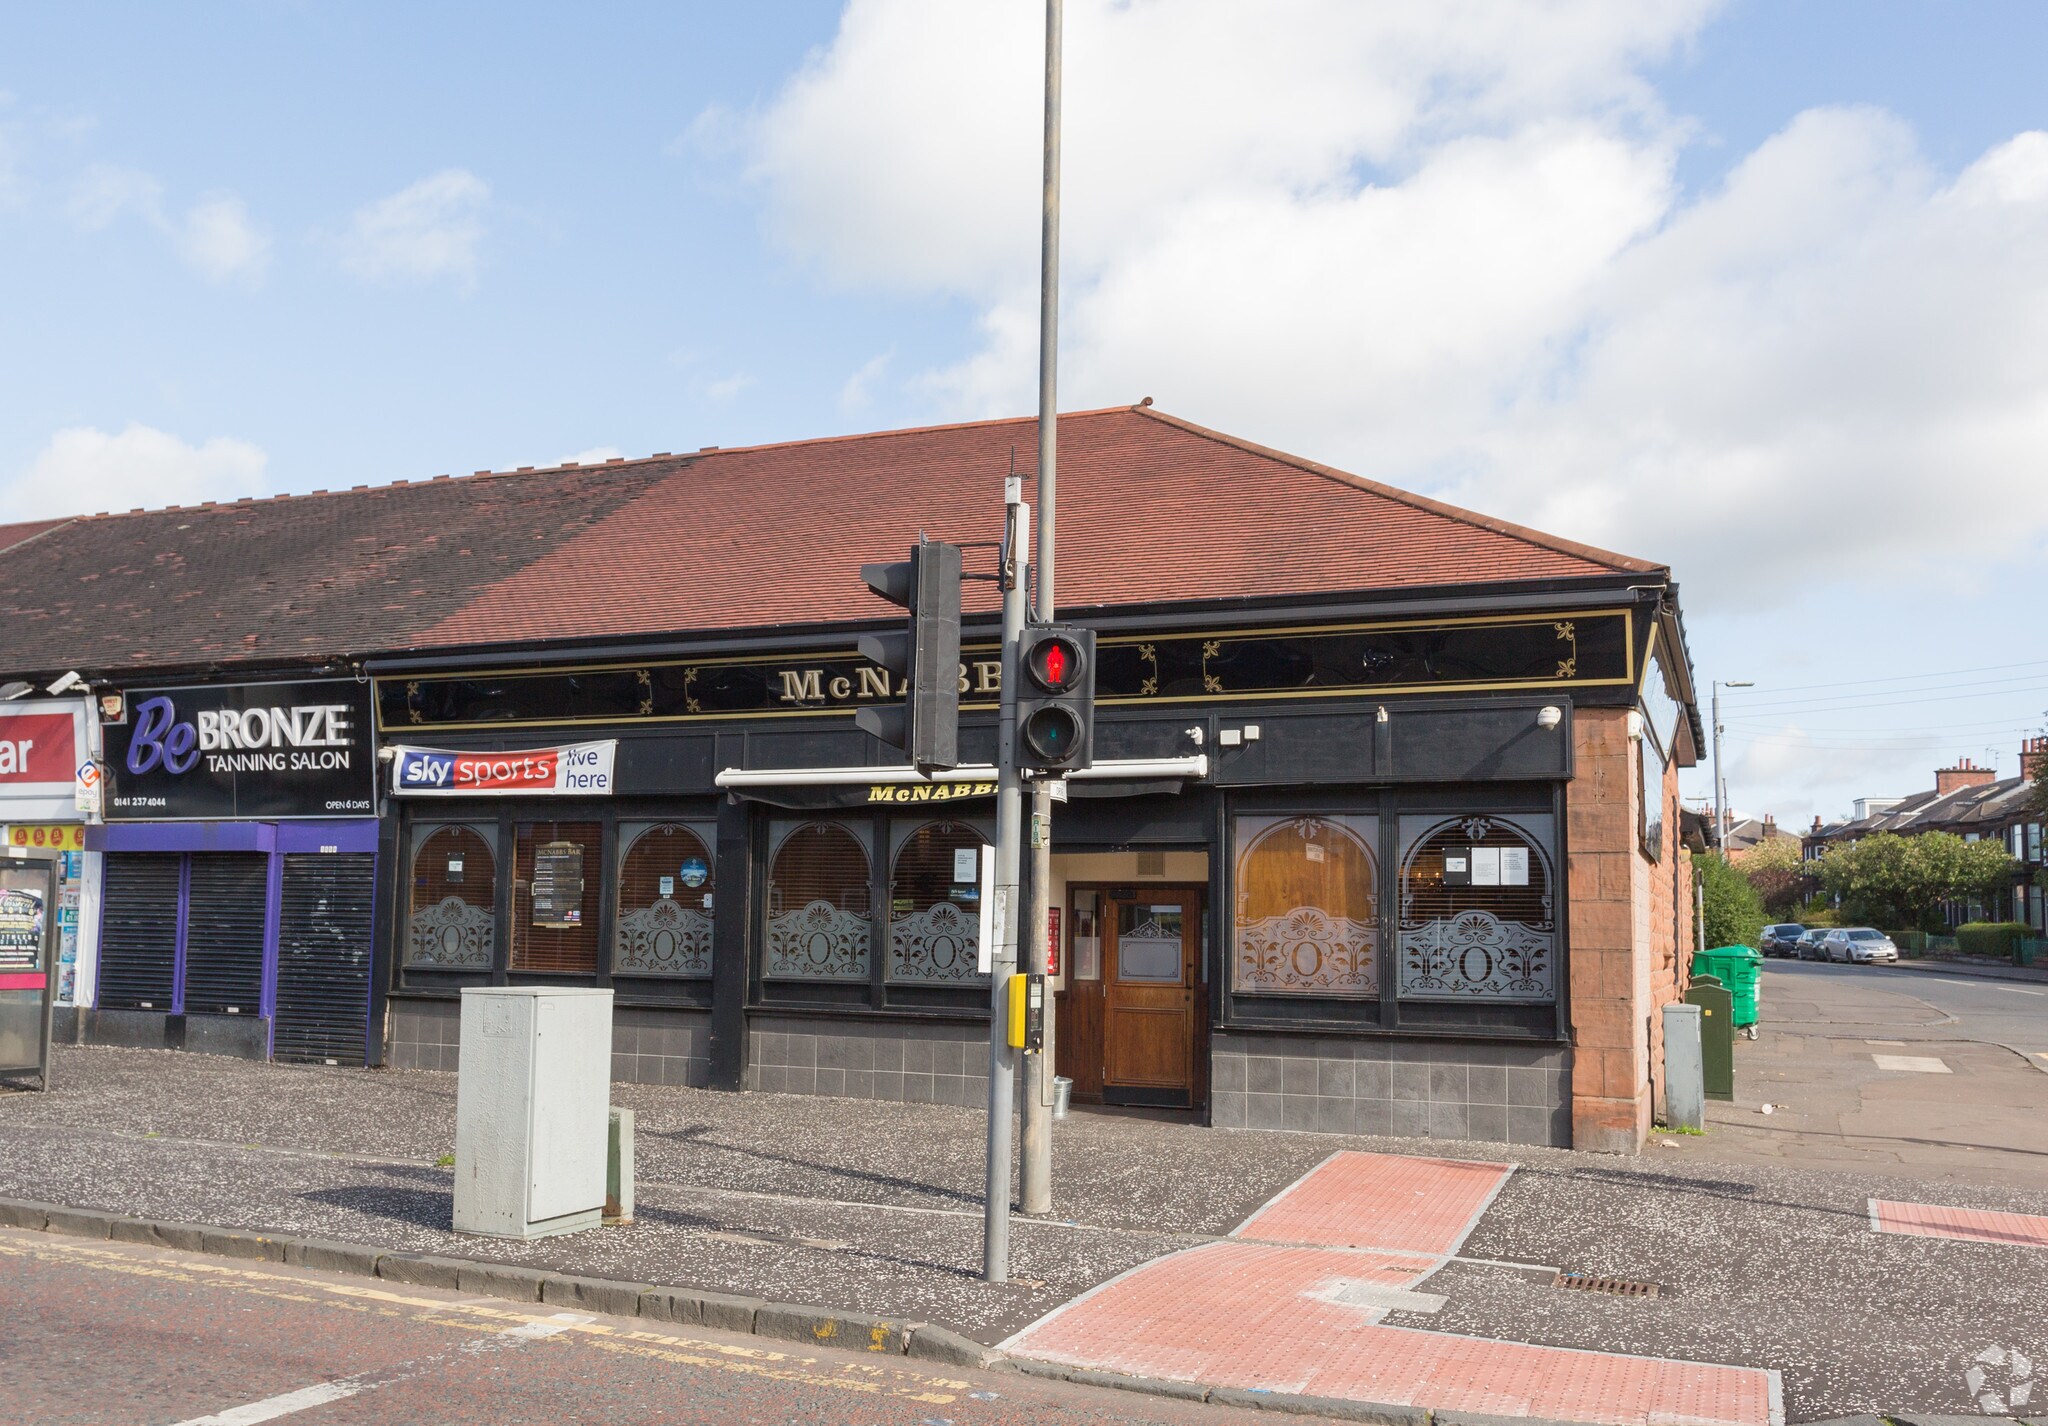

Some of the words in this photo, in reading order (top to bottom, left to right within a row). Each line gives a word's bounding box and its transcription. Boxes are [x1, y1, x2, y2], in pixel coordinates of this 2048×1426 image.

[127, 696, 201, 775] Be
[198, 704, 350, 750] BRONZE
[206, 753, 286, 772] TANNING
[290, 751, 350, 770] SALON
[566, 749, 598, 766] live
[407, 755, 451, 786] sky
[459, 758, 551, 787] sports
[565, 770, 607, 788] here
[867, 783, 999, 802] McNABB
[326, 801, 345, 810] OPEN
[346, 800, 352, 809] 6
[352, 801, 370, 809] DAYS
